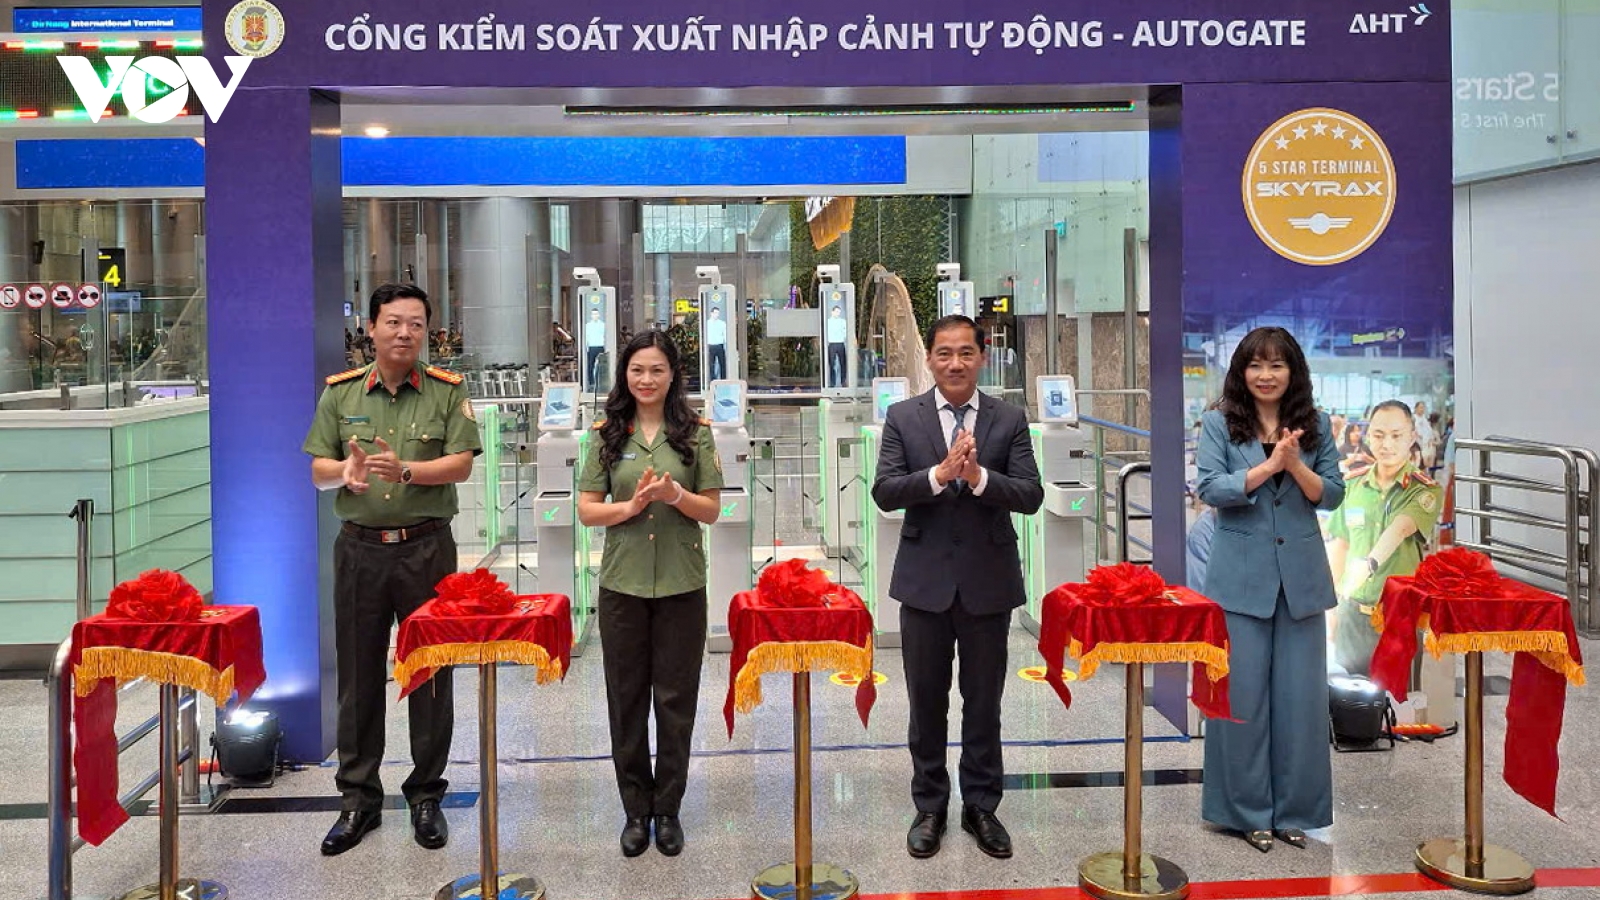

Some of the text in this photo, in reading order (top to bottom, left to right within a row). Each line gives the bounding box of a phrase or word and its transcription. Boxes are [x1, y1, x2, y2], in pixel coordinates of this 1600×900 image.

[71, 20, 131, 28] International
[133, 19, 174, 27] Terminal
[1349, 13, 1408, 34] AHT
[325, 13, 427, 51] CỔNG
[438, 13, 525, 51] KIỂM
[536, 17, 622, 51] SOÁT
[632, 15, 722, 51] XUẤT
[732, 16, 828, 58] NHẬP
[837, 14, 934, 51] CẢNH
[943, 20, 994, 56] TỰ
[1001, 15, 1103, 55] ĐỘNG
[1132, 20, 1306, 47] AUTOGATE
[1259, 160, 1380, 175] 5 STAR TERMINAL
[1256, 181, 1384, 197] SKYTRAX
[103, 264, 121, 287] 4
